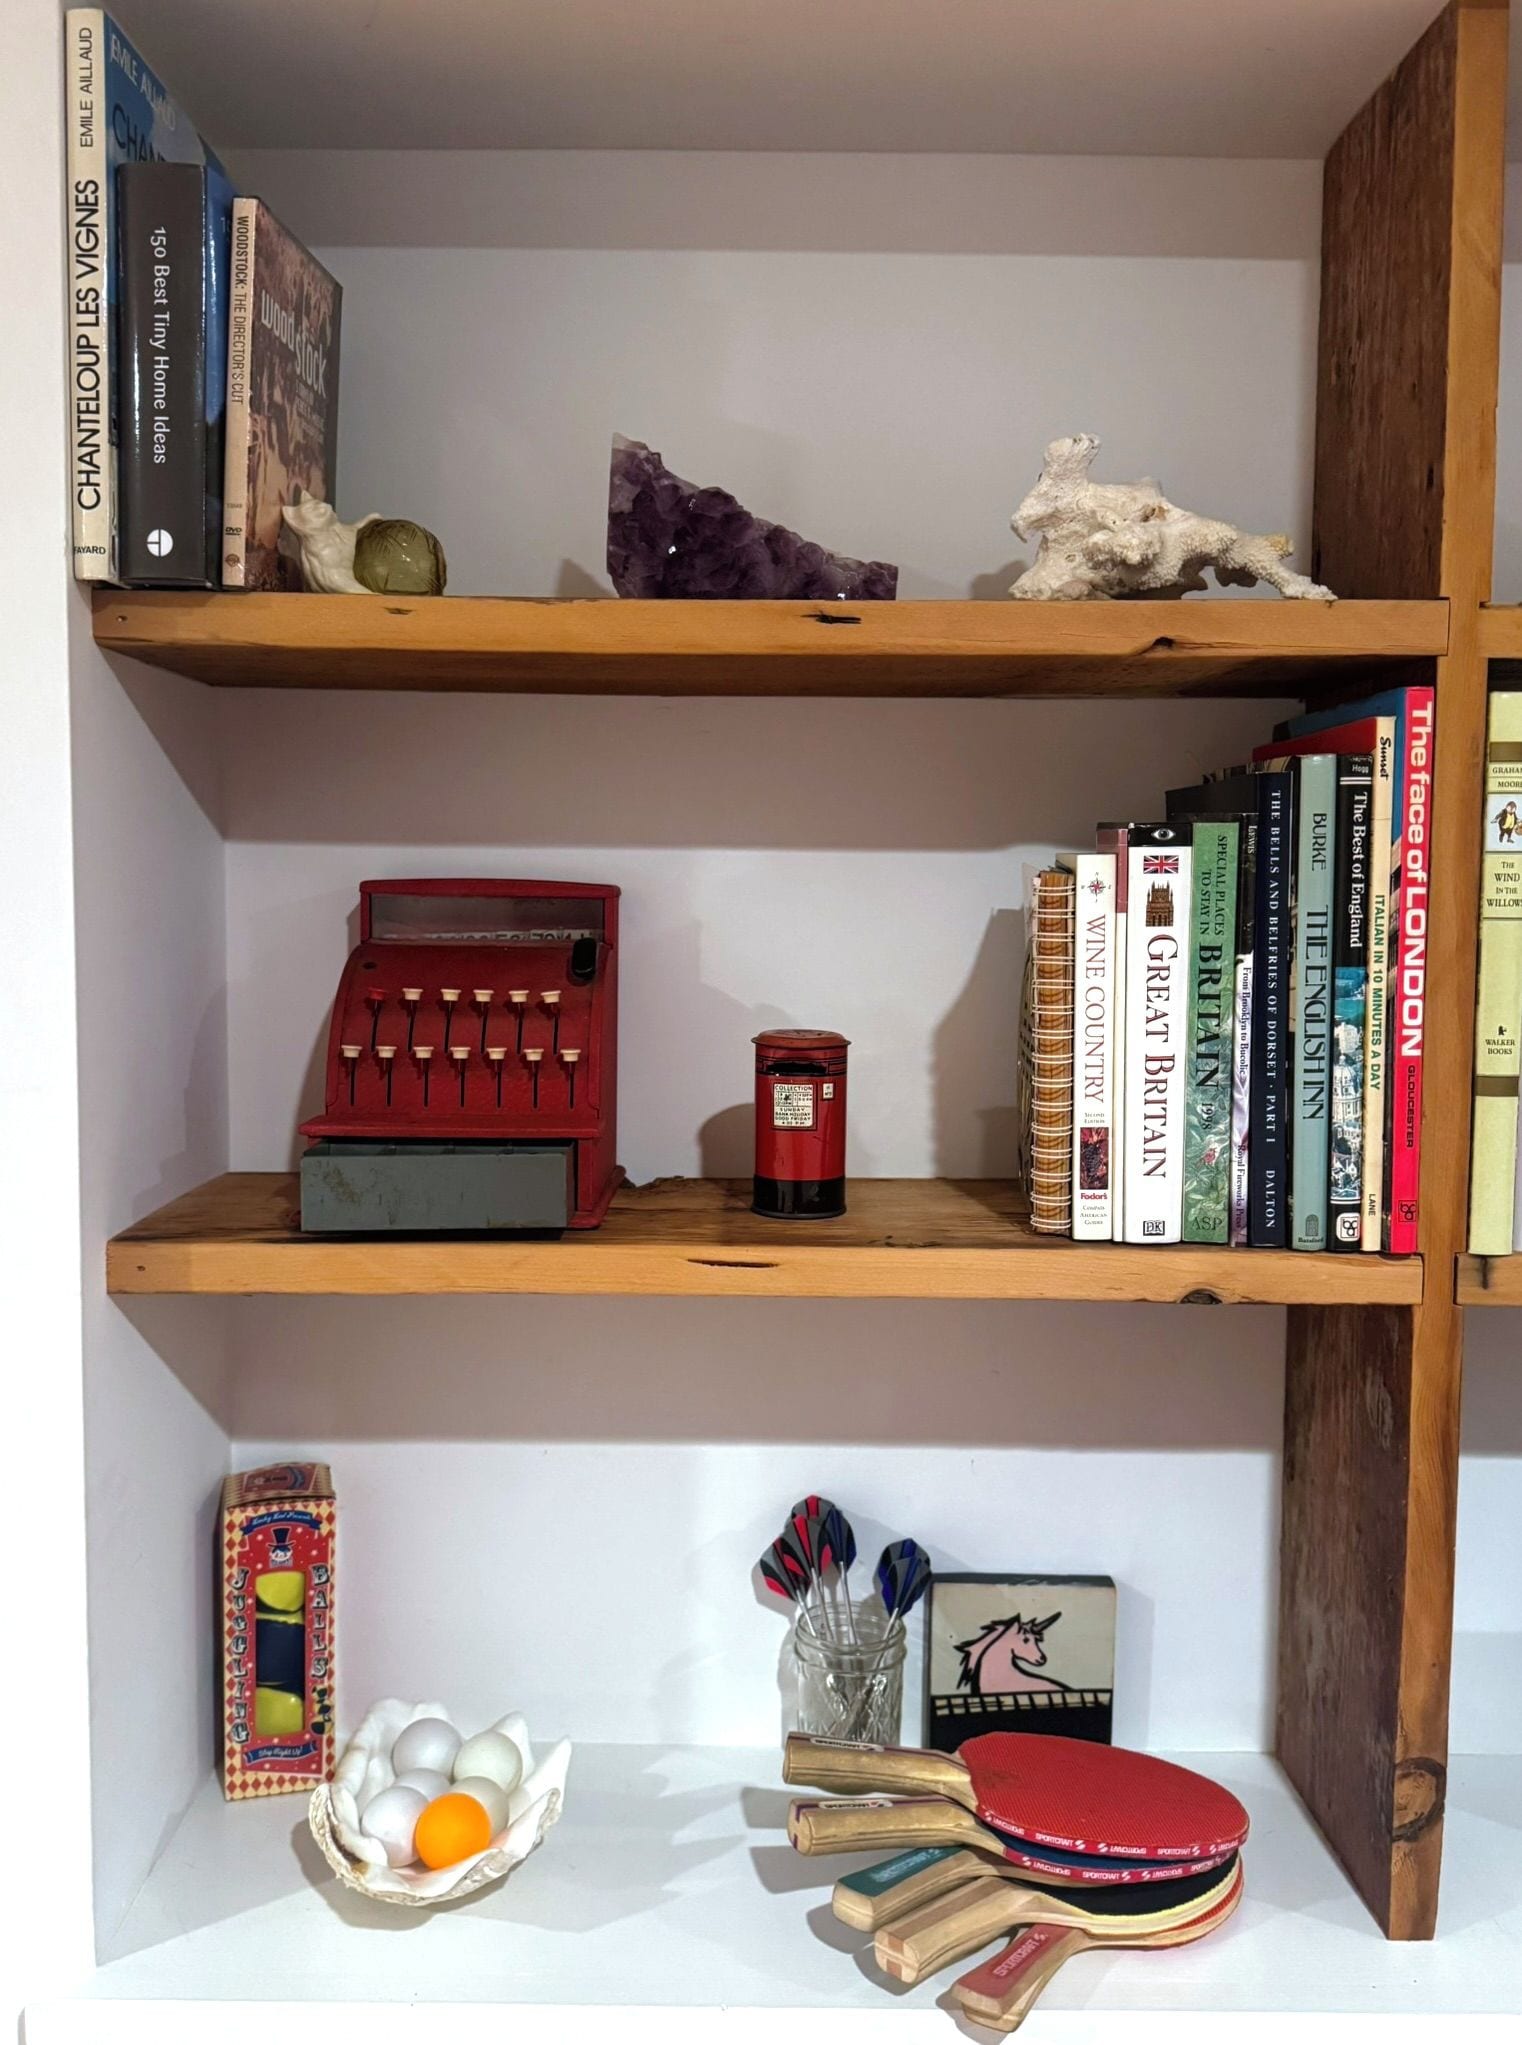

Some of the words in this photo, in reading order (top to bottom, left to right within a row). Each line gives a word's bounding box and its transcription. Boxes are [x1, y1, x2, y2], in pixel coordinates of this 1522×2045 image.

[79, 27, 93, 94] AILLAUD
[80, 99, 93, 148] EMILE
[75, 180, 99, 280] VIGNES
[150, 226, 167, 258] 150
[234, 215, 249, 289] WOODSTOCK:
[153, 265, 170, 305] Best
[233, 292, 248, 313] THE
[76, 287, 100, 327] LES
[261, 289, 295, 353] wood
[150, 311, 170, 350] Tiny
[231, 316, 247, 380] DIRECTOR'S
[295, 324, 327, 399] stock
[153, 356, 170, 410] Home
[231, 382, 245, 405] CUT
[76, 334, 101, 510] CHANTELOUP
[153, 416, 171, 464] Ideas
[74, 545, 106, 555] FAYARD
[1410, 701, 1433, 767] The
[1352, 764, 1369, 773] Hogg
[1379, 736, 1392, 780] Sunset
[1271, 790, 1281, 820] THE
[1353, 791, 1368, 822] The
[1408, 770, 1430, 845] face
[1215, 835, 1228, 887] SPECIAL
[1270, 827, 1280, 874] BELLS
[1312, 813, 1328, 871] BURKE
[1352, 825, 1367, 861] Best
[1201, 869, 1212, 886] TO
[1351, 862, 1365, 882] of
[1406, 849, 1428, 883] of
[1494, 872, 1520, 882] WIND
[1200, 890, 1211, 920] STAY
[1214, 891, 1226, 936] PLACES
[1269, 879, 1279, 910] AND
[1200, 922, 1210, 936] IN
[1305, 905, 1329, 960] THE
[1348, 883, 1365, 948] England
[1374, 894, 1385, 946] ITALIAN
[1085, 914, 1106, 979] WINE
[1267, 917, 1279, 989] BELFRIES
[1373, 951, 1384, 964] IN
[1145, 934, 1179, 1043] GREAT
[1242, 967, 1252, 991] From
[1372, 969, 1383, 983] 10
[1401, 886, 1427, 1057] LONDON
[1195, 943, 1223, 1089] BRITAIN
[1238, 992, 1251, 1032] Brooklyn
[1267, 996, 1277, 1014] OF
[1303, 965, 1328, 1074] ENGLISH
[1371, 987, 1383, 1046] MINUTES
[1084, 986, 1106, 1103] COUNTRY
[1240, 1033, 1250, 1041] to
[1266, 1020, 1277, 1079] DORSET
[1371, 1050, 1381, 1059] A
[1485, 1038, 1516, 1046] WALKER
[1240, 1043, 1249, 1075] Bucolic
[1370, 1063, 1381, 1091] DAY
[1143, 1053, 1175, 1178] BRITAIN
[1201, 1102, 1213, 1131] 1998
[1266, 1095, 1276, 1132] PART
[1302, 1080, 1325, 1120] INN
[1406, 1065, 1415, 1148] GLOUCESTER
[1236, 1144, 1246, 1168] Royal
[1080, 1192, 1108, 1200] Fodor's
[1236, 1168, 1245, 1207] Fireworks
[1265, 1170, 1276, 1228] DALTON
[1368, 1194, 1376, 1217] LANE
[1145, 1221, 1164, 1234] DK
[1191, 1216, 1223, 1231] ASP
[1235, 1208, 1245, 1228] Press
[310, 1564, 330, 1678] BALLS
[231, 1568, 250, 1743] JUGGLING
